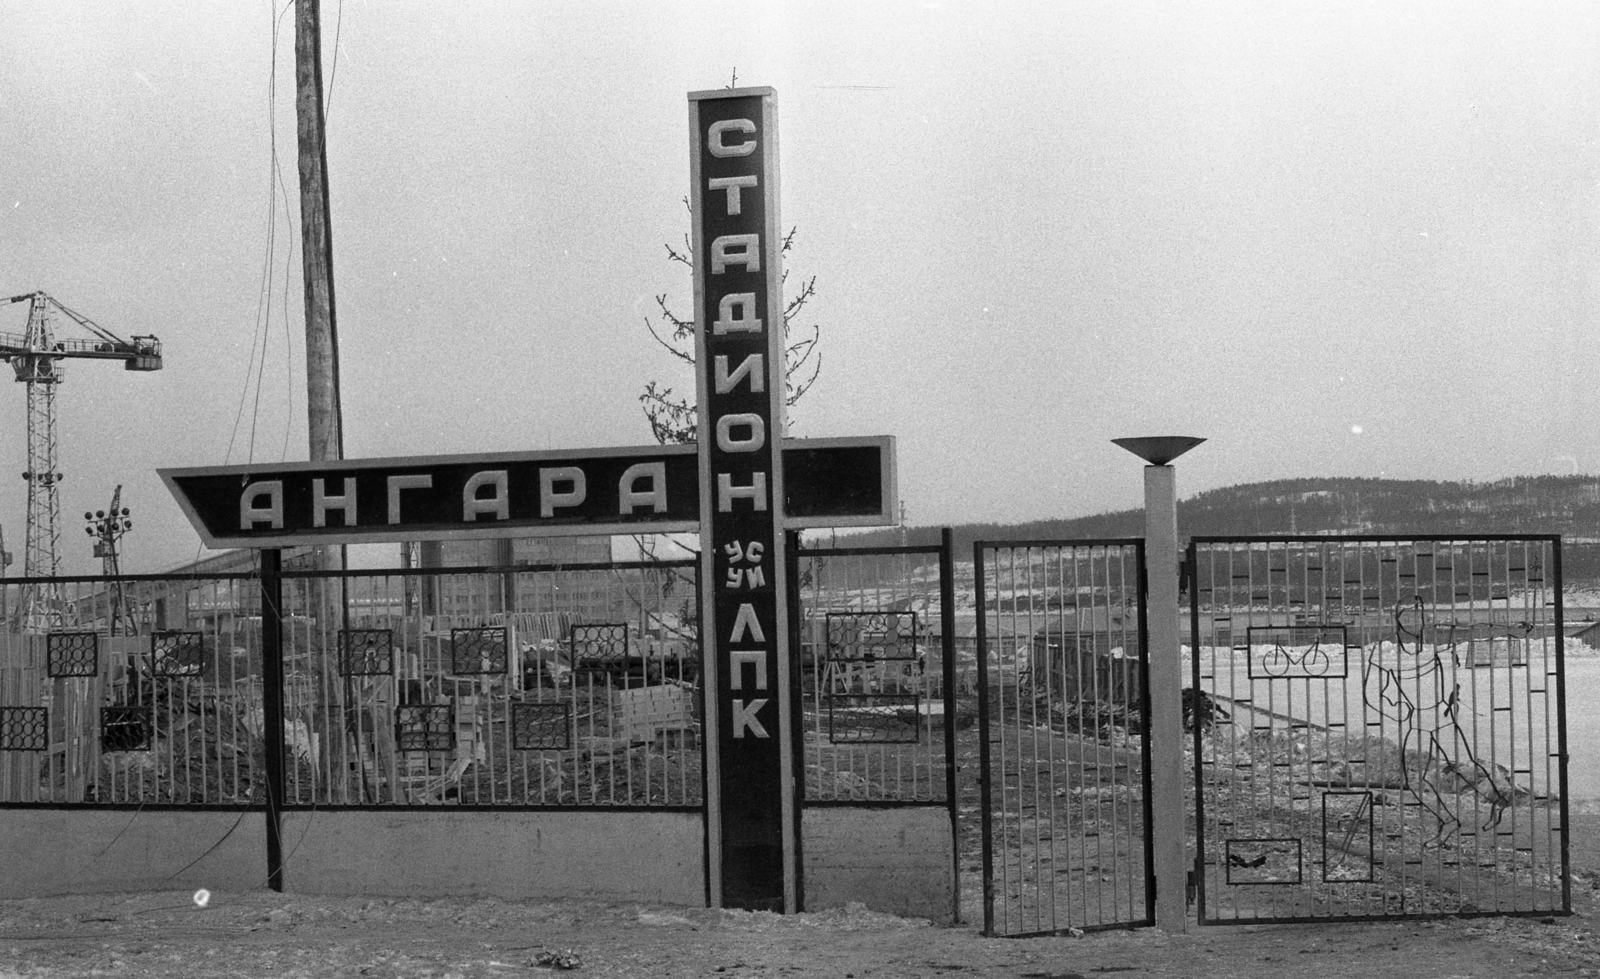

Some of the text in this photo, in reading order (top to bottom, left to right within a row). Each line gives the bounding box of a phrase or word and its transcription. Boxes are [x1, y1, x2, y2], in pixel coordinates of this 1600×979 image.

[708, 118, 767, 512] СТАДИОН
[240, 461, 668, 530] АНГАРА
[729, 603, 770, 738] ЛПК
